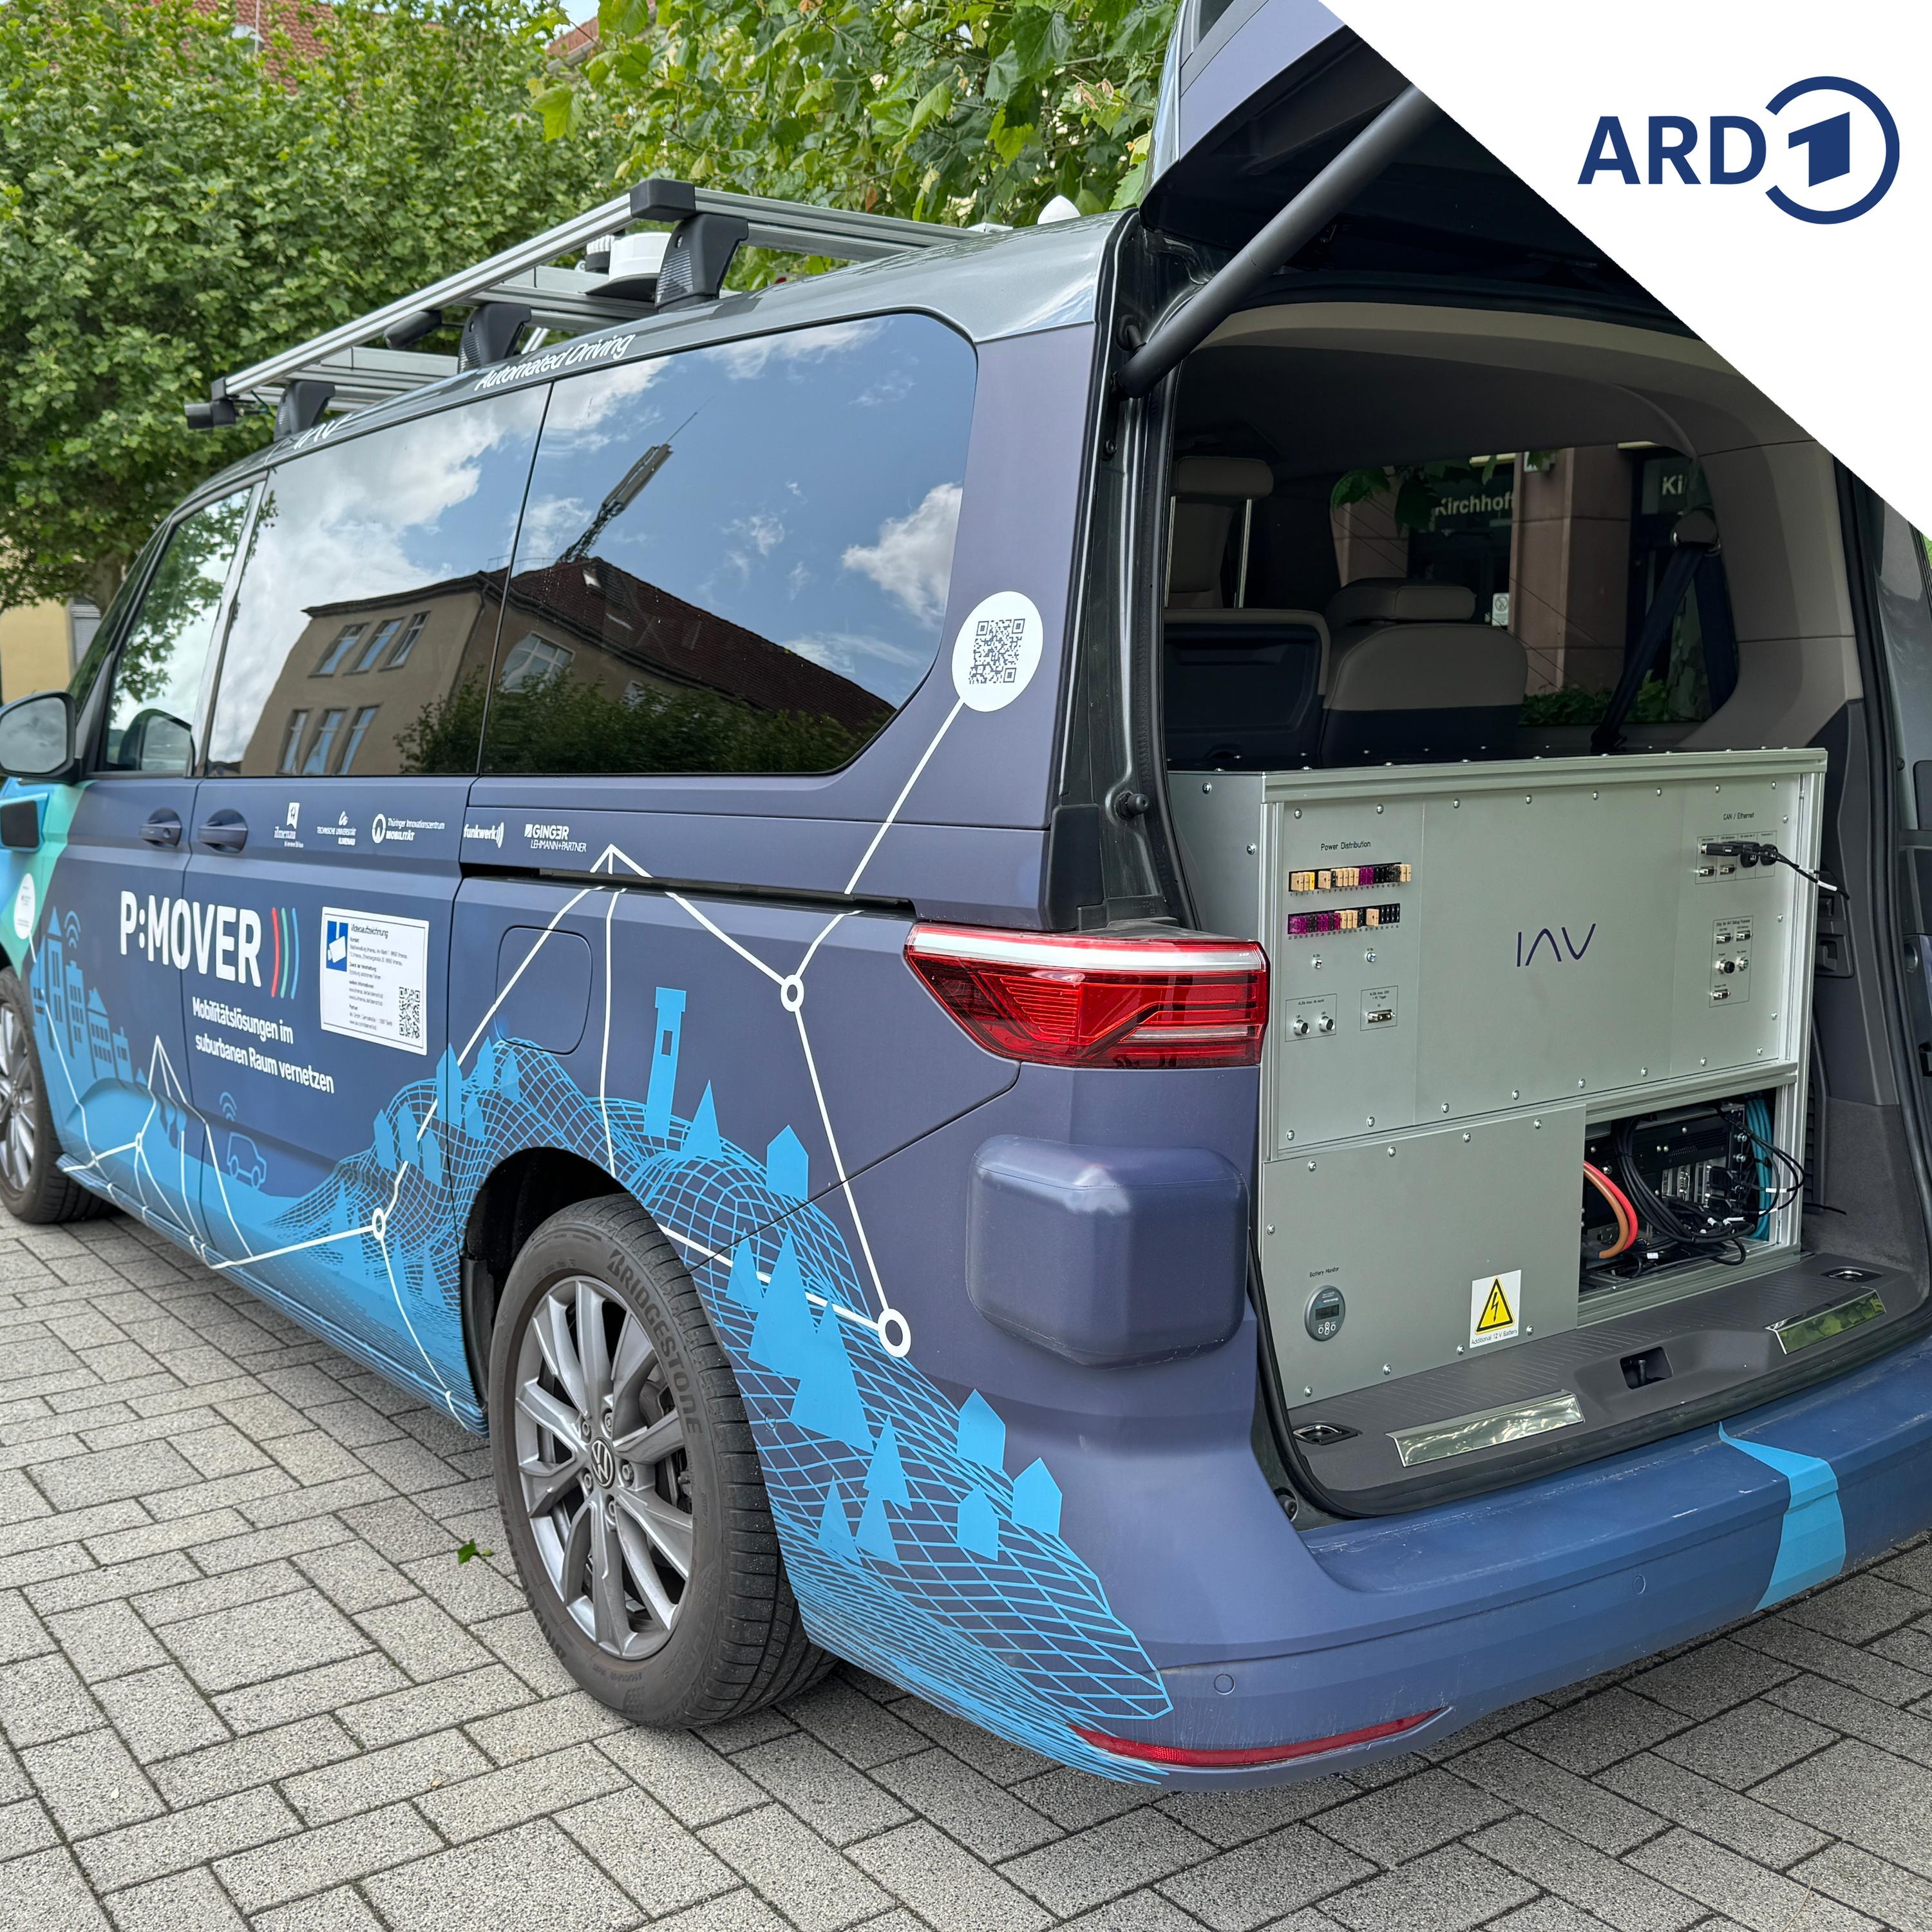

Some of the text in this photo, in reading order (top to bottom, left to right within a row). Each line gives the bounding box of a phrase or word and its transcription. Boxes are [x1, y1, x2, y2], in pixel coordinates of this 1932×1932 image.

[474, 334, 636, 391] Automated Driving
[386, 829, 415, 840] MOBILITÄT
[464, 824, 498, 840] funkwerk
[532, 824, 569, 840] GINGER
[531, 839, 587, 853] LEHMANN+PARTNER
[1341, 841, 1371, 850] Distribution
[120, 891, 261, 987] P:MOVER
[193, 996, 294, 1044] Mobilitätslösungen im
[195, 1033, 334, 1094] suburbanen Raum vernetzen
[607, 1248, 702, 1434] BRIDGESTONE
[1472, 1334, 1492, 1345] Additional
